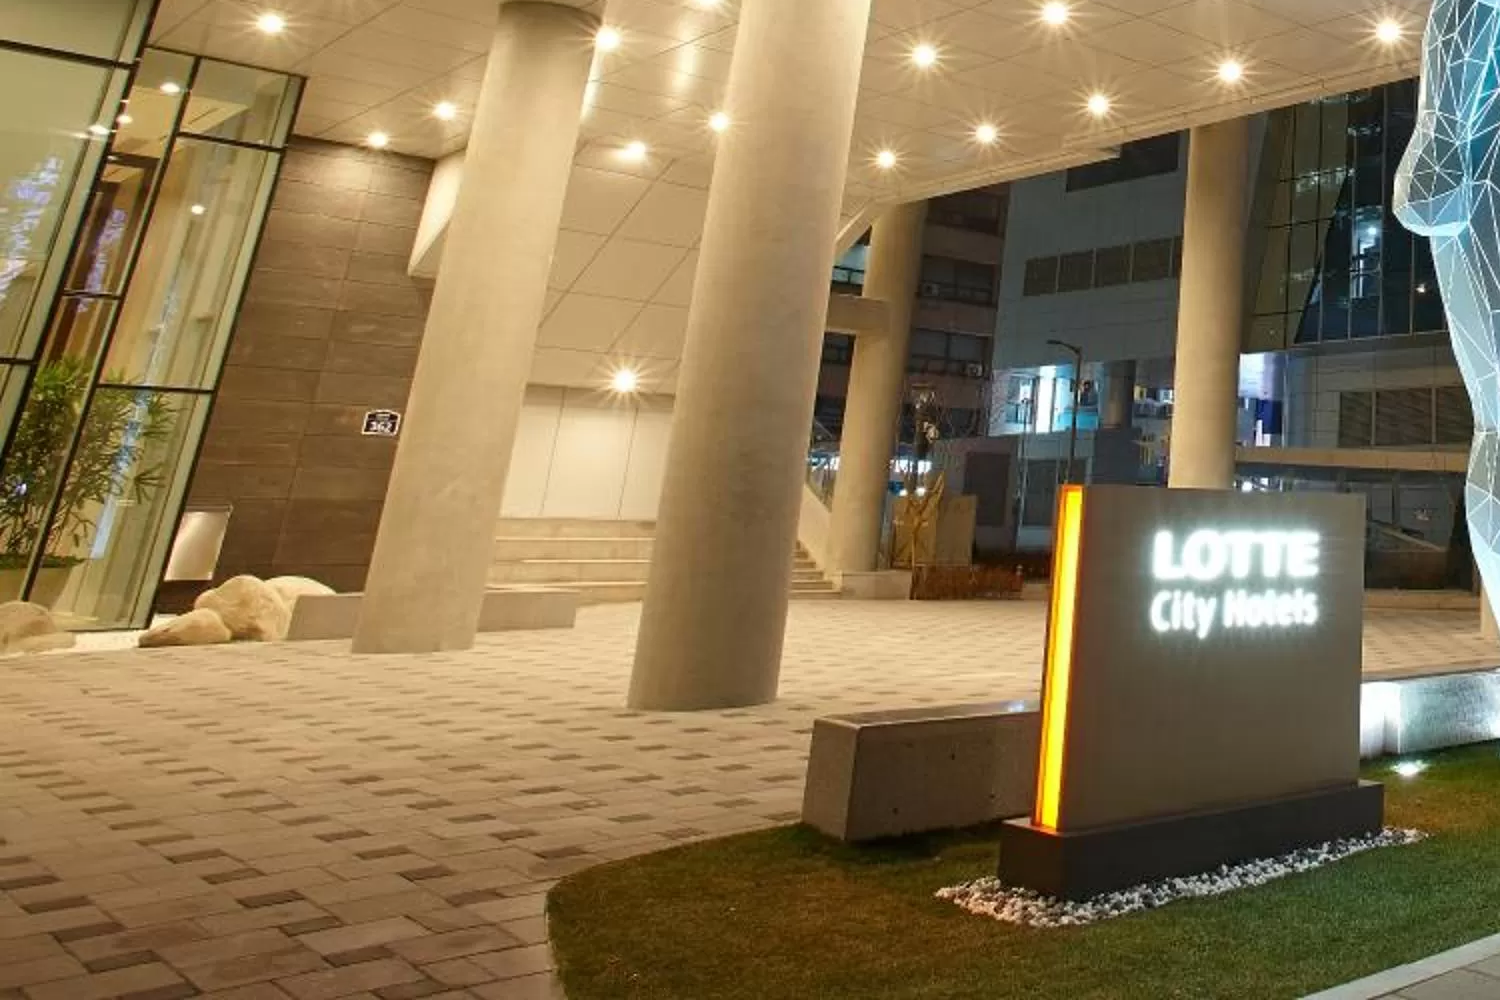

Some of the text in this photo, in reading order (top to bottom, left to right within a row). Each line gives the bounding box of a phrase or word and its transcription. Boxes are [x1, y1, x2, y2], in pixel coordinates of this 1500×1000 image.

[1151, 529, 1321, 581] LOTTE
[1149, 588, 1319, 640] City Hotels
